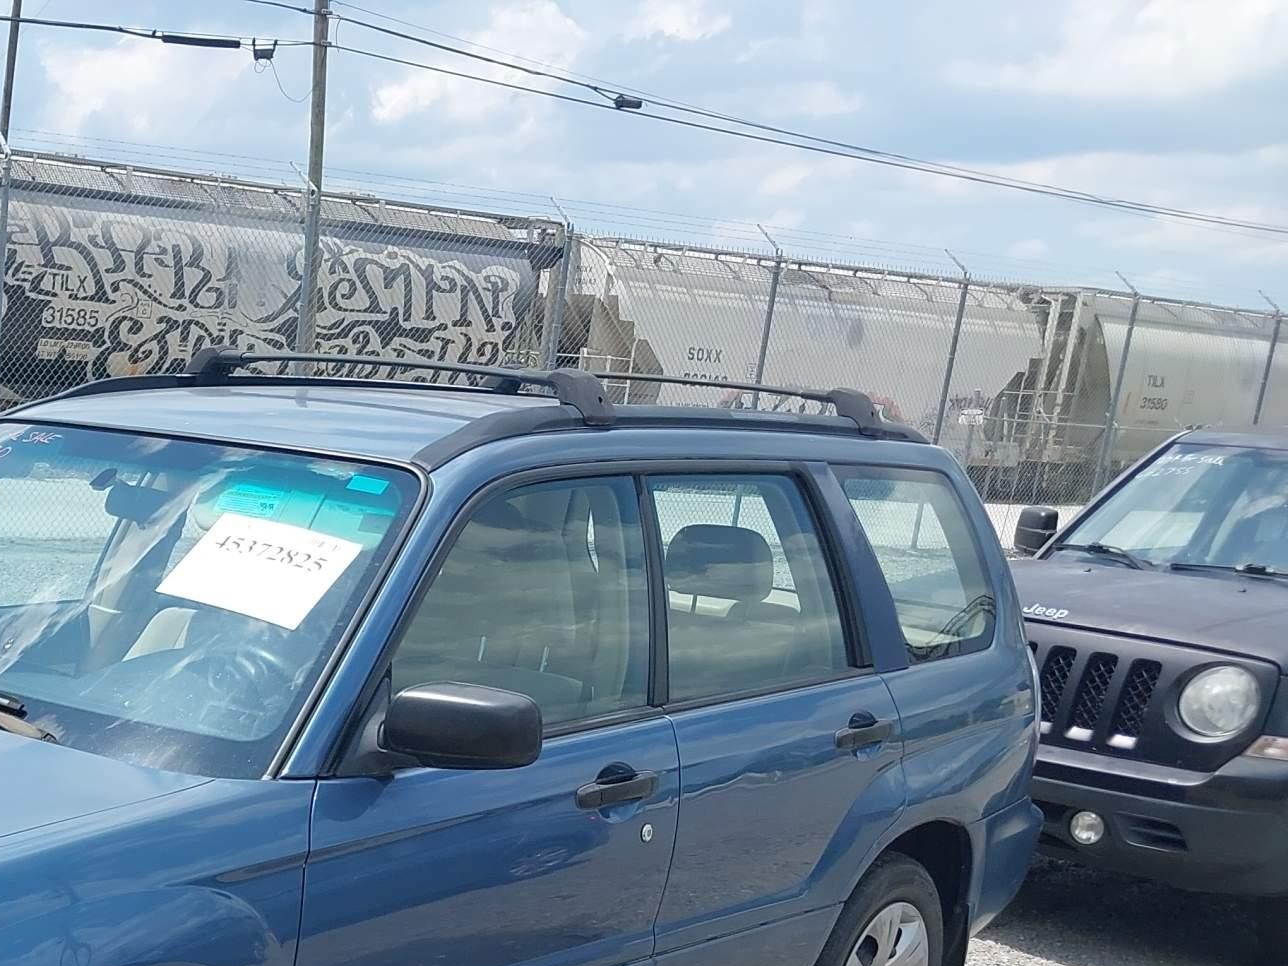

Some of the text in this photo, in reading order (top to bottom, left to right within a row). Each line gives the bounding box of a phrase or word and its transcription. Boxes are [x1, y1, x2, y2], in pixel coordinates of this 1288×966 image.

[48, 271, 89, 294] TILX
[43, 305, 100, 328] 31585
[687, 346, 723, 364] SOXX
[215, 535, 329, 573] 45372825
[1022, 603, 1069, 619] Jeep
